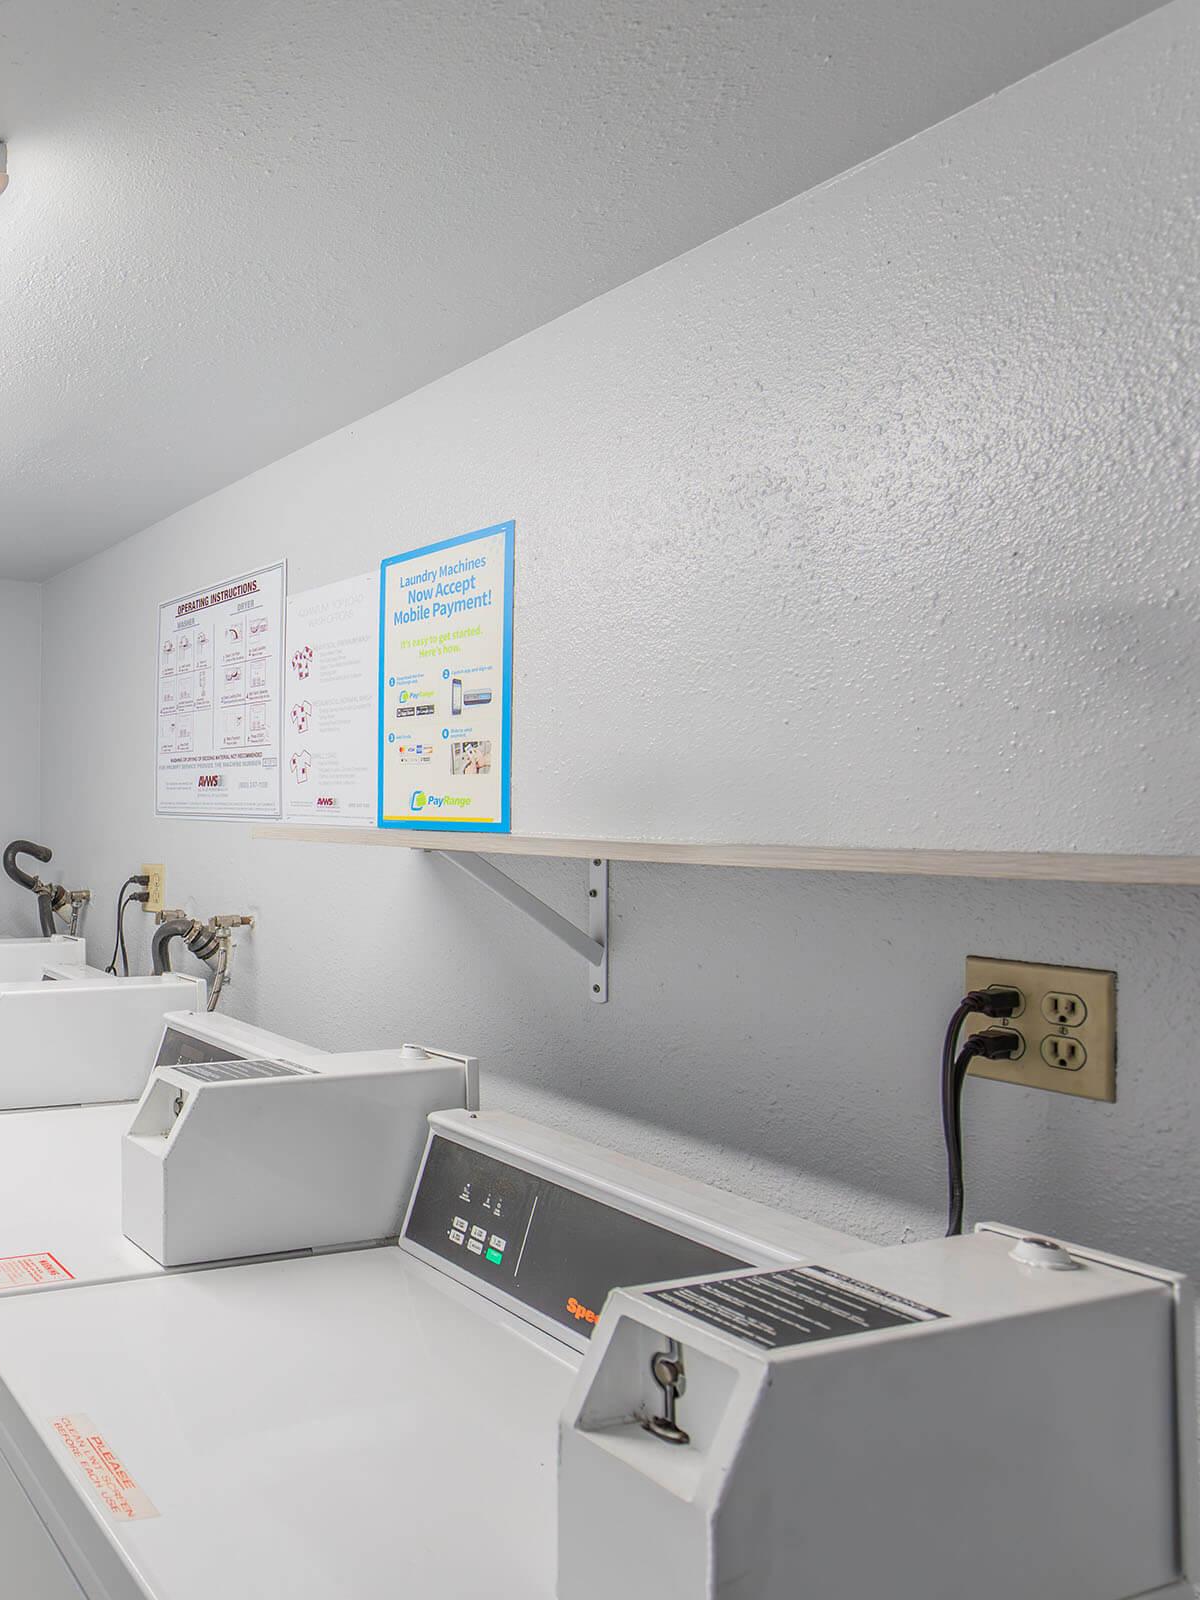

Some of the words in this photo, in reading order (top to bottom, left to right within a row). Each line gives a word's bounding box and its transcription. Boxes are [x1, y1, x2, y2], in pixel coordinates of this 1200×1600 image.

[400, 569, 437, 588] Laundry
[439, 556, 487, 577] Machines
[177, 596, 209, 615] OPERATING
[210, 580, 257, 604] INSTRUCTIONS
[408, 588, 433, 604] Now
[435, 575, 476, 598] Accept
[237, 600, 254, 611] DRYER
[393, 605, 430, 626] Mobile
[432, 589, 492, 618] Payment!
[439, 631, 450, 645] get
[428, 795, 471, 808] PayRange
[61, 1417, 86, 1448] CLEAN
[54, 1422, 81, 1457] BEFORE
[80, 1461, 101, 1488] EACH
[101, 1491, 120, 1513] USE
[91, 1436, 136, 1489] PLEASE
